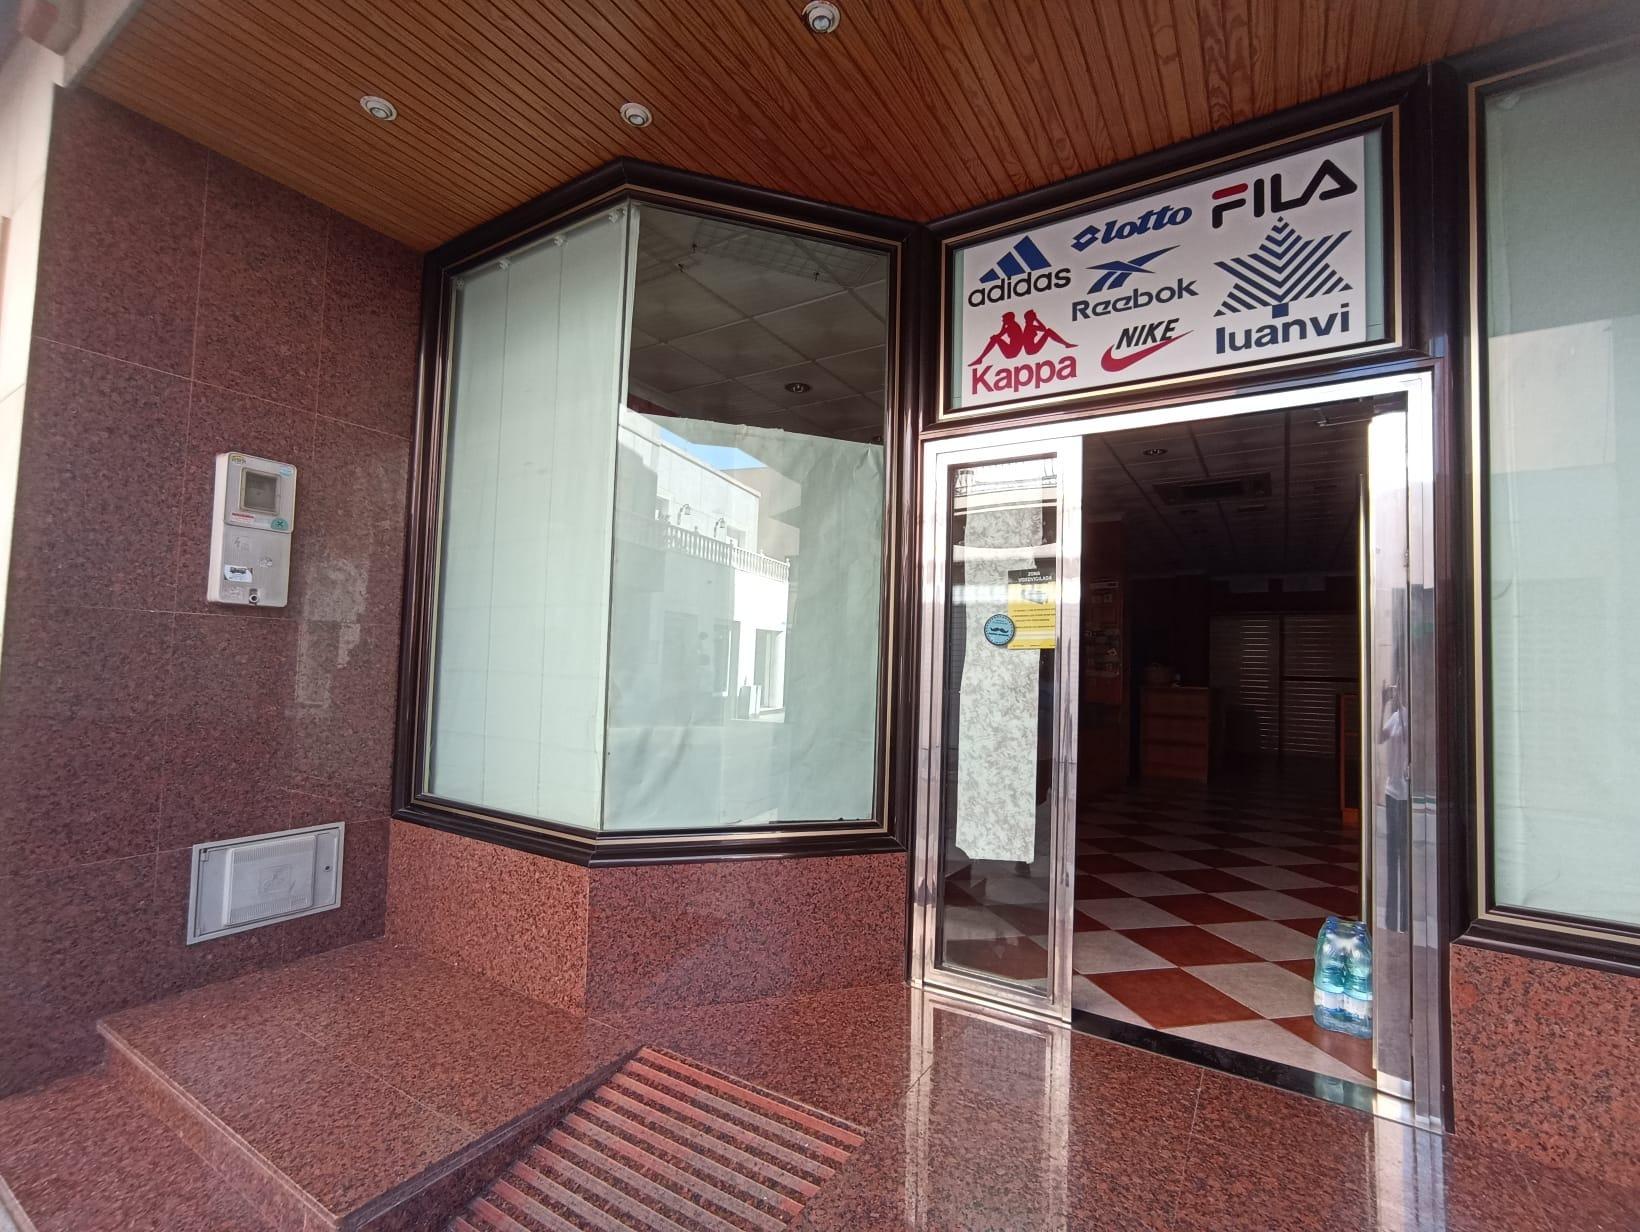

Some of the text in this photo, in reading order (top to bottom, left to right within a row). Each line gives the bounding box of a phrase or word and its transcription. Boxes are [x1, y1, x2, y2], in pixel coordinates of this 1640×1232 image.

[1211, 158, 1358, 230] FILA
[1101, 205, 1193, 245] lotto
[967, 265, 1072, 308] adidas
[1071, 277, 1199, 322] Reebok
[1115, 318, 1180, 350] NIKE
[1215, 302, 1350, 355] luanvi
[972, 355, 1077, 395] Kappa
